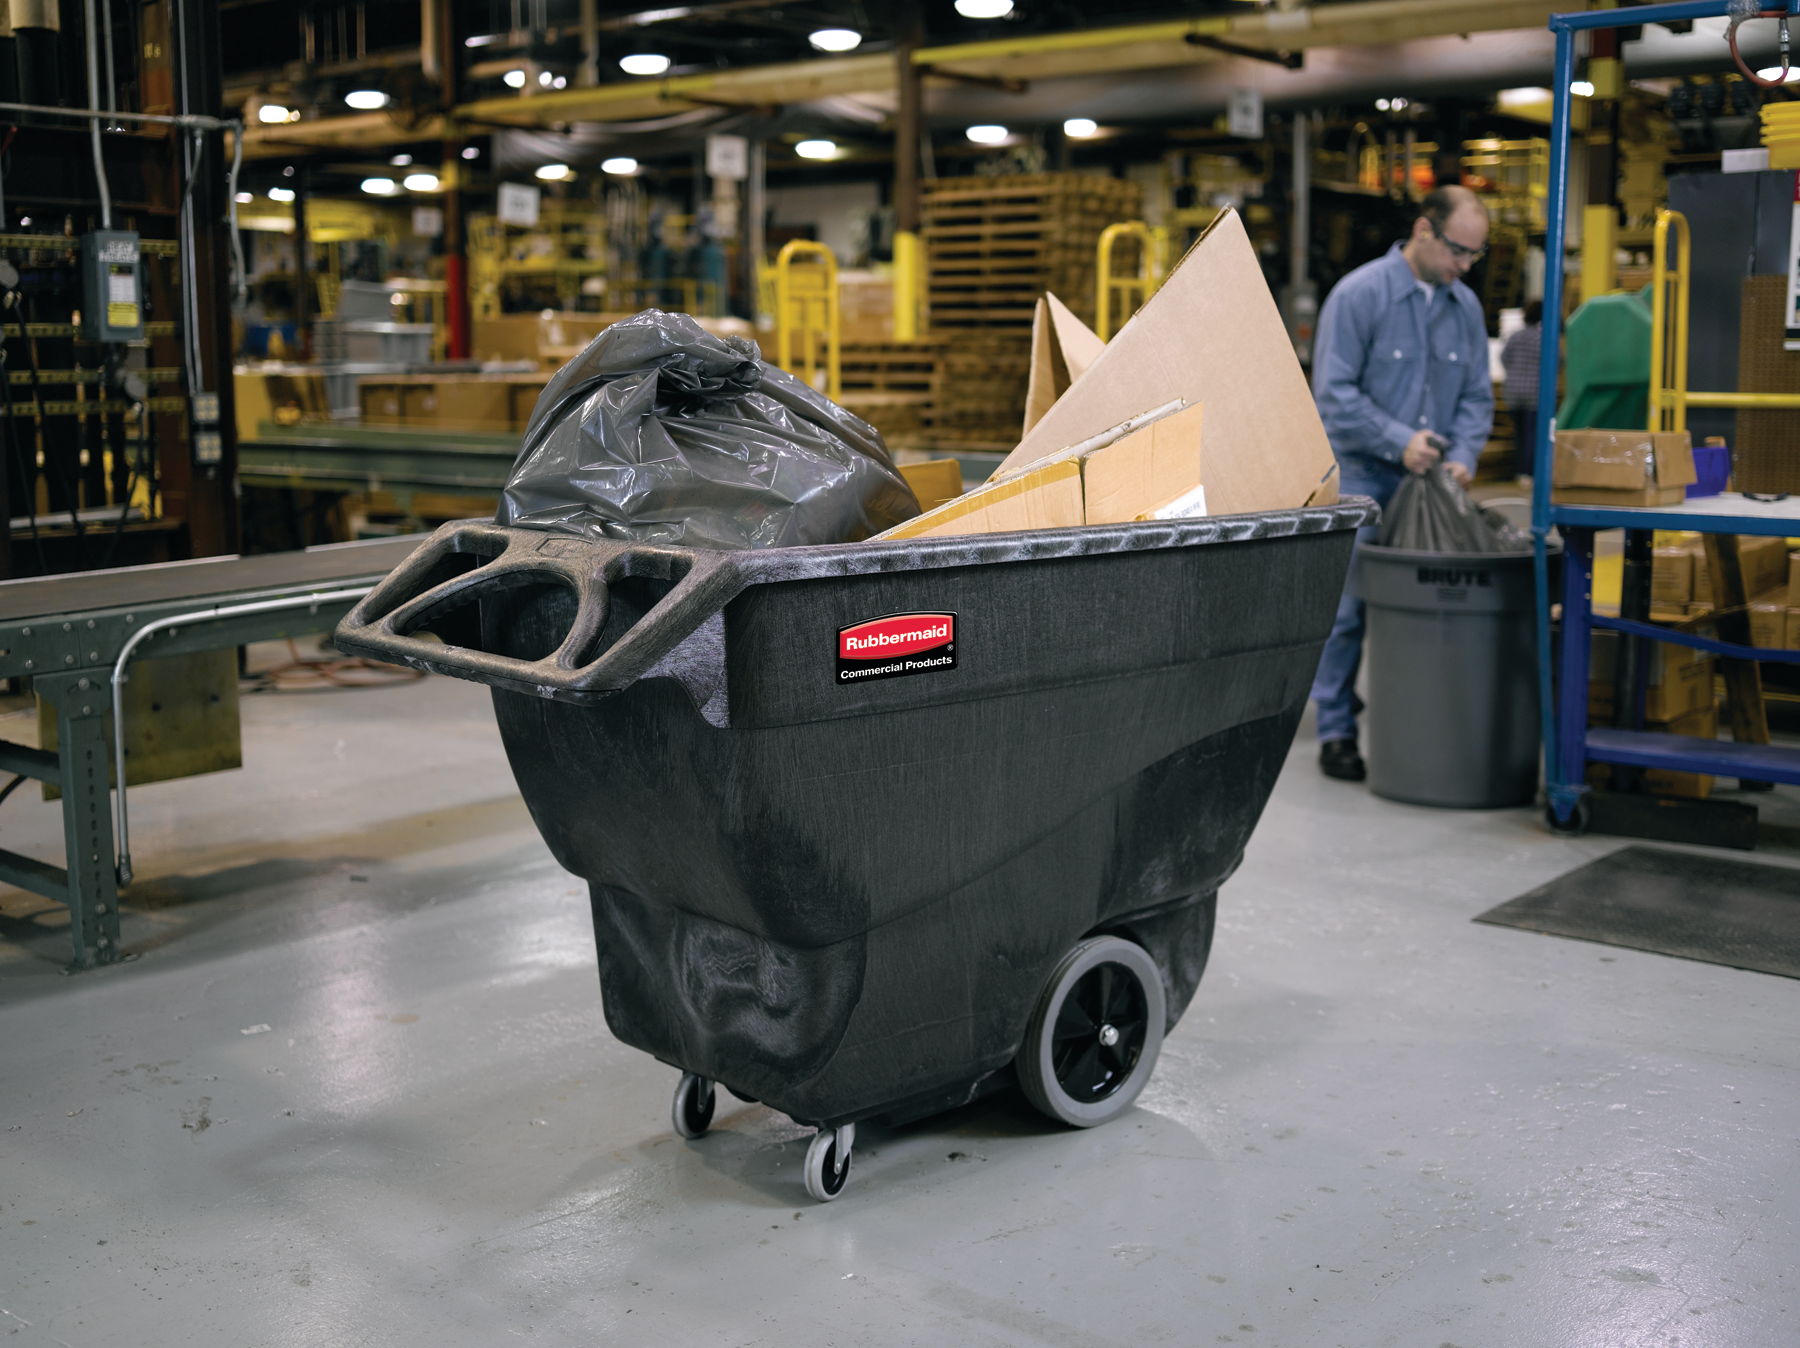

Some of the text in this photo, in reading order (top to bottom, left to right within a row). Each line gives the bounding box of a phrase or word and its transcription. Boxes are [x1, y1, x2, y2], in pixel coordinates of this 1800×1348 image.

[1417, 567, 1491, 587] BRUTE
[846, 623, 948, 651] Rubbermaid
[840, 656, 953, 679] Commercial Products
